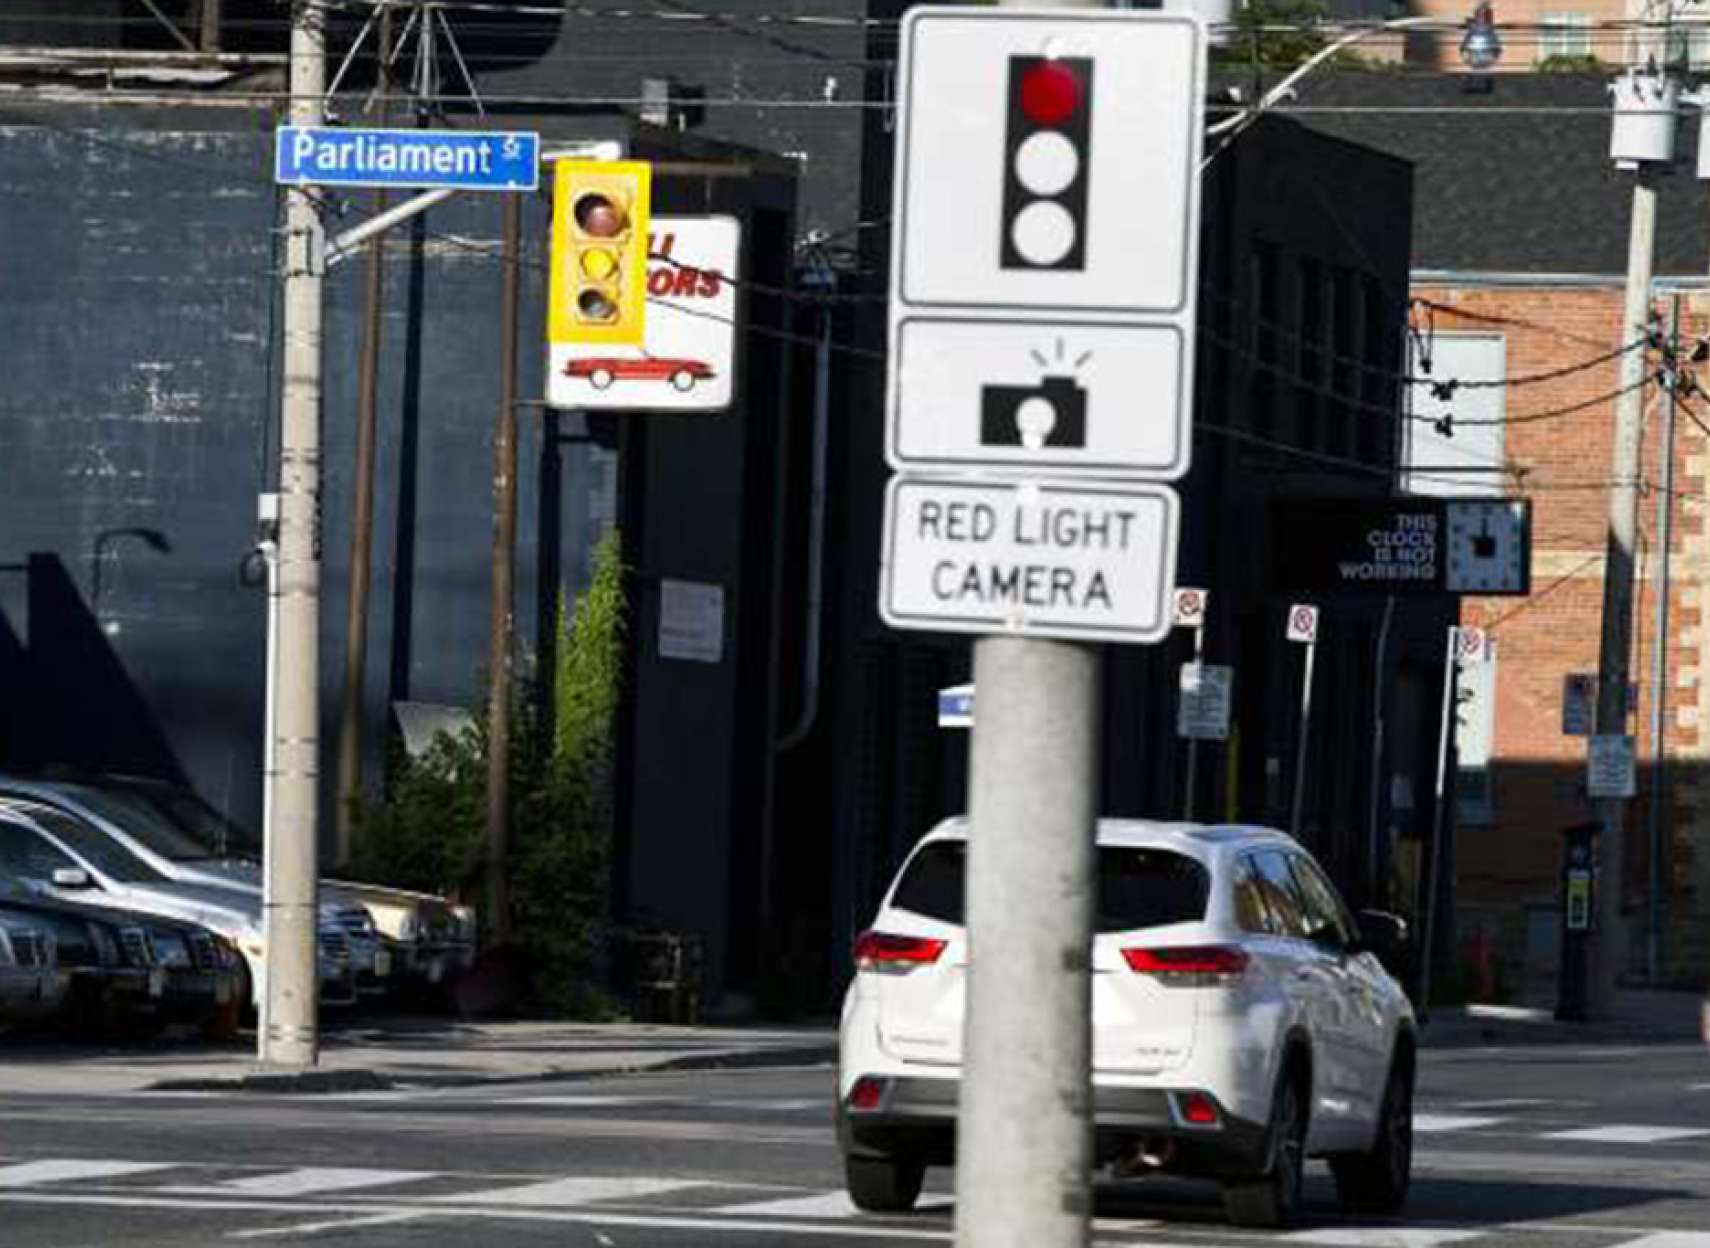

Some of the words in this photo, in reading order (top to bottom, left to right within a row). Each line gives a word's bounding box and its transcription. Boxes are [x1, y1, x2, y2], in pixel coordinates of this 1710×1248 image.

[293, 134, 491, 174] Parliament
[647, 267, 722, 297] ORS
[917, 501, 997, 541] RED
[1013, 506, 1136, 548] LIGHT
[1396, 514, 1438, 529] THIS
[1366, 530, 1436, 547] CLOCK
[1374, 547, 1392, 562] IS
[1398, 547, 1436, 562] NOT
[1338, 562, 1436, 580] WORKING
[931, 560, 1113, 609] CAMERA
